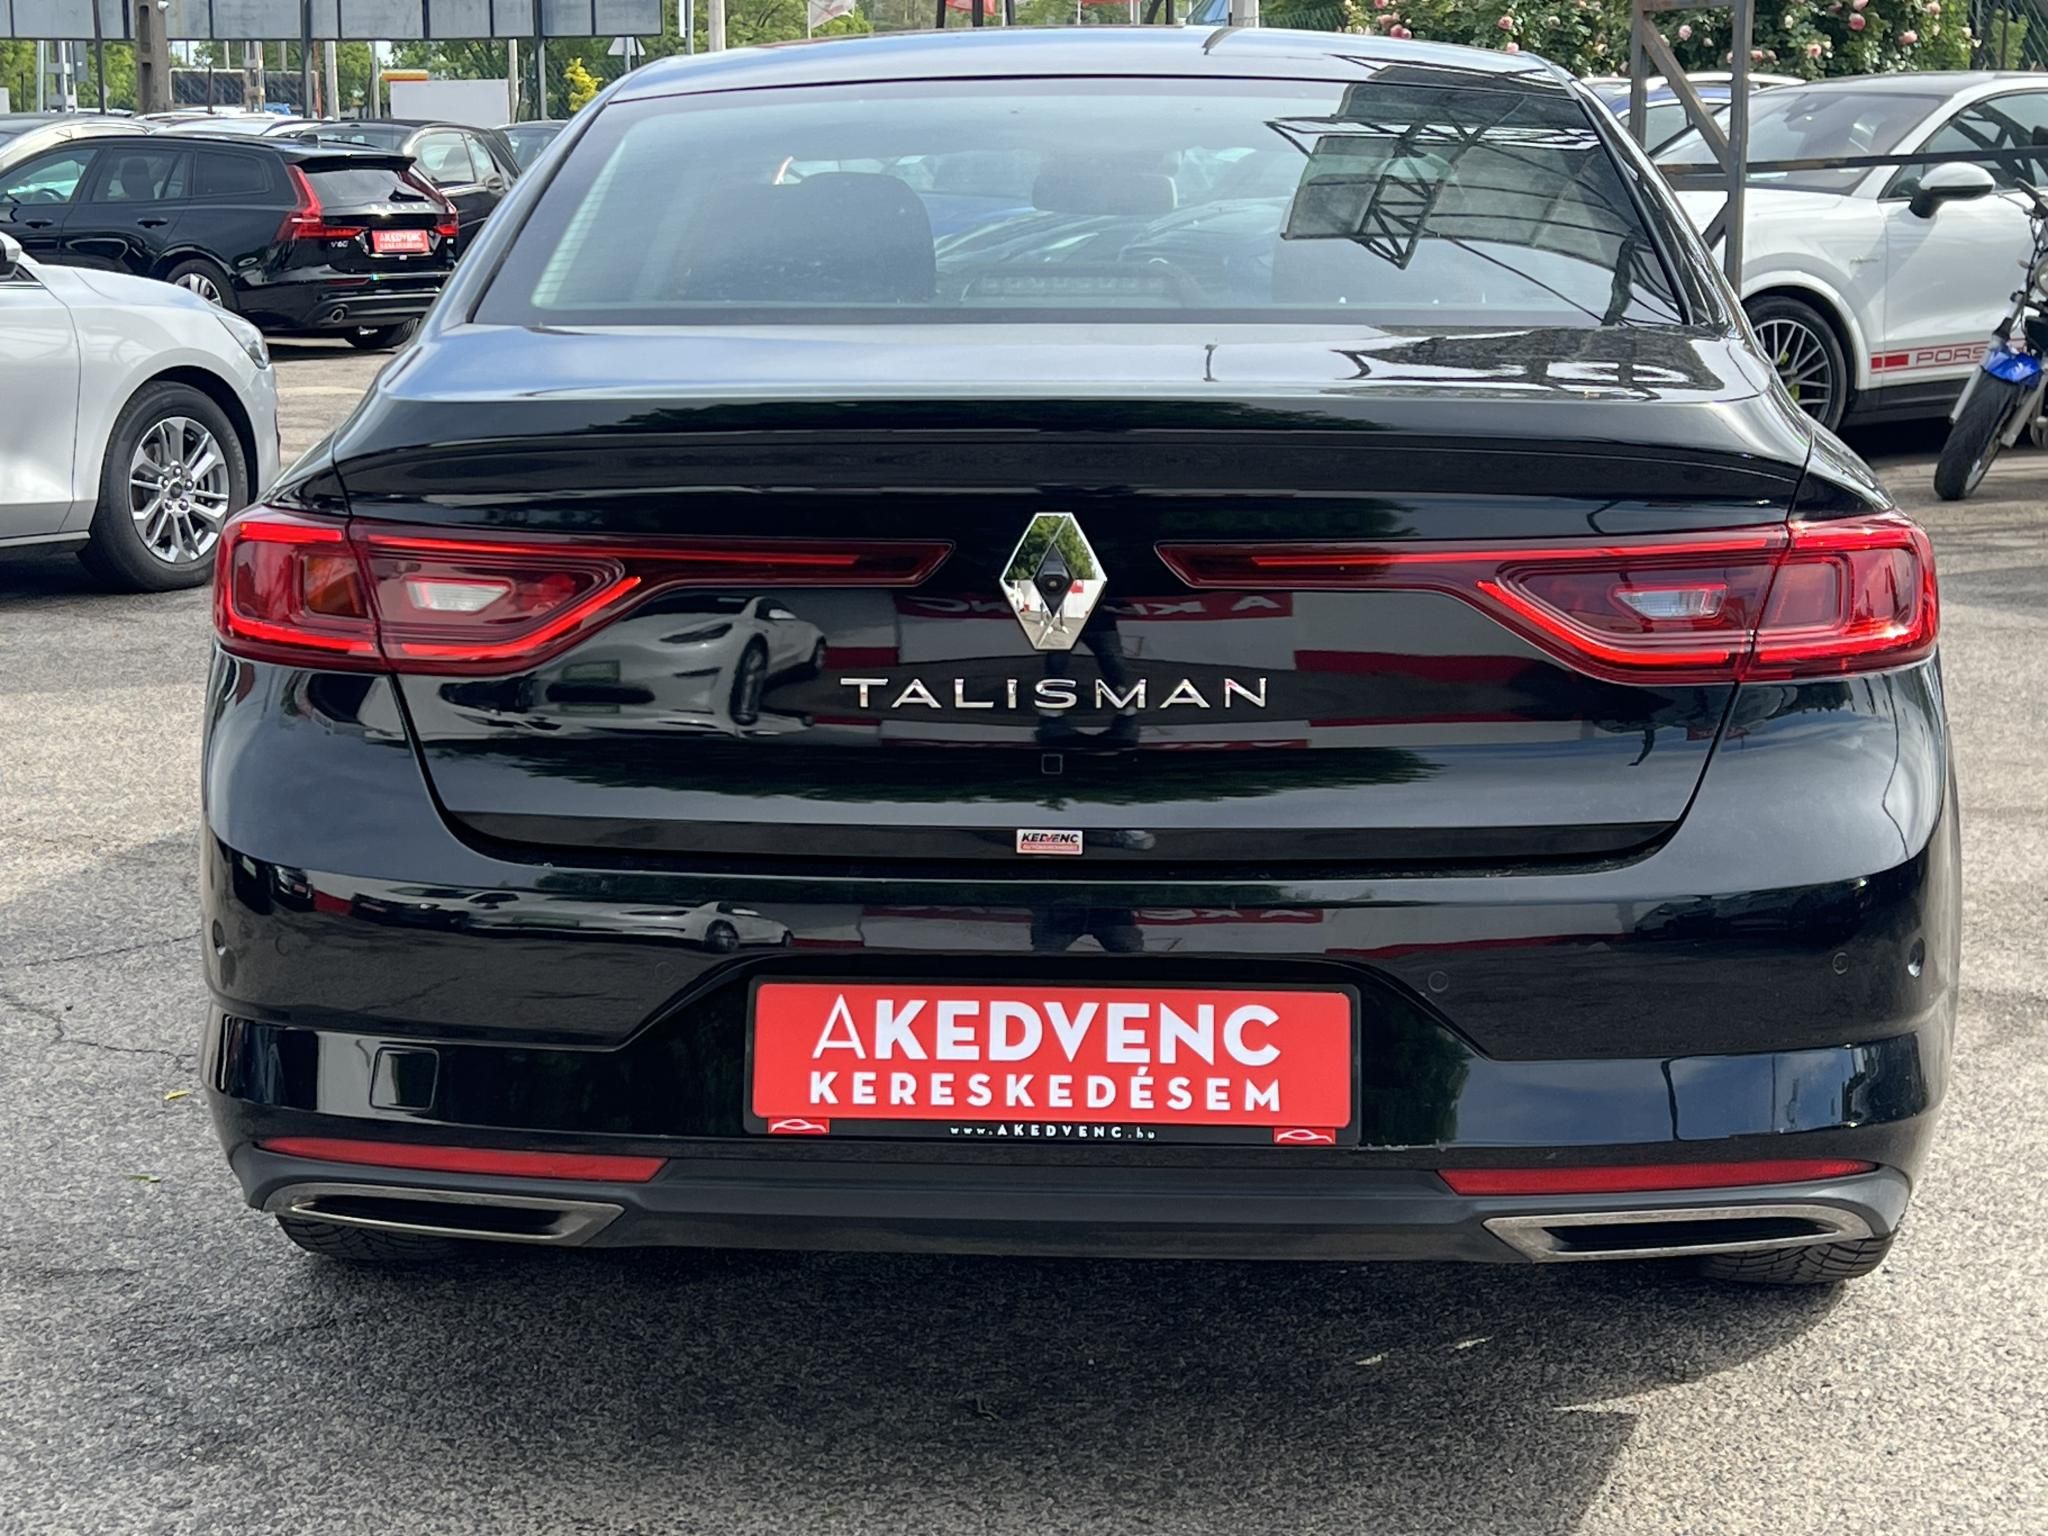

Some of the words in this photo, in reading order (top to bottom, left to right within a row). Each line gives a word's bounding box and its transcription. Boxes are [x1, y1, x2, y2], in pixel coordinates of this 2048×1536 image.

[1916, 346, 1986, 364] PORS
[840, 677, 1267, 709] TALISMAN
[1022, 833, 1079, 843] KEDVENC
[809, 1066, 1280, 1112] KERESKEDÉSEM
[950, 1124, 1155, 1139] www.AKEDVENC.hu
